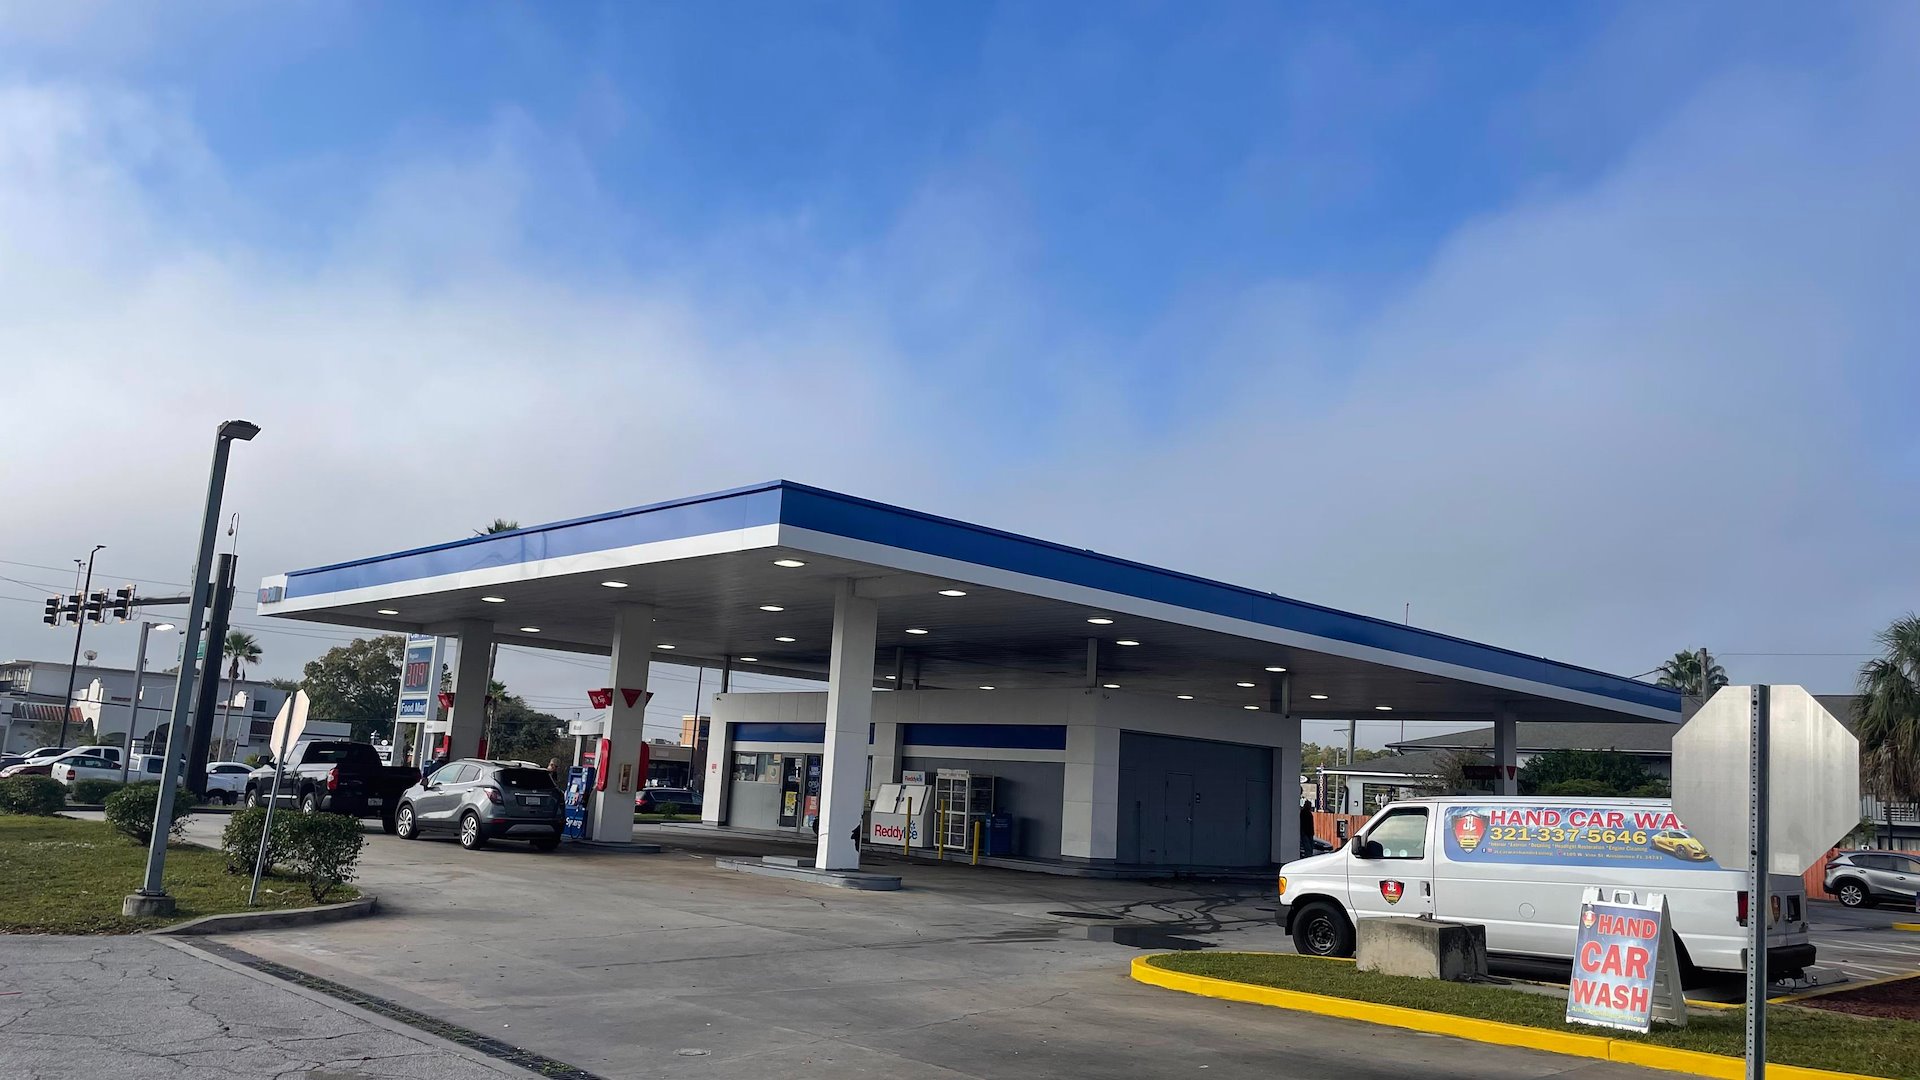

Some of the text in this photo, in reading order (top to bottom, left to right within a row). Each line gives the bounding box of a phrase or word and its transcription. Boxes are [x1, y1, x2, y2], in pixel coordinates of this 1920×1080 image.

[401, 702, 414, 713] Food
[1490, 810, 1688, 830] HAND CAR WA
[1489, 827, 1647, 845] 321-337-5646
[1598, 914, 1658, 939] HAND
[1581, 941, 1650, 979] CAR
[1572, 978, 1649, 1013] WASH
